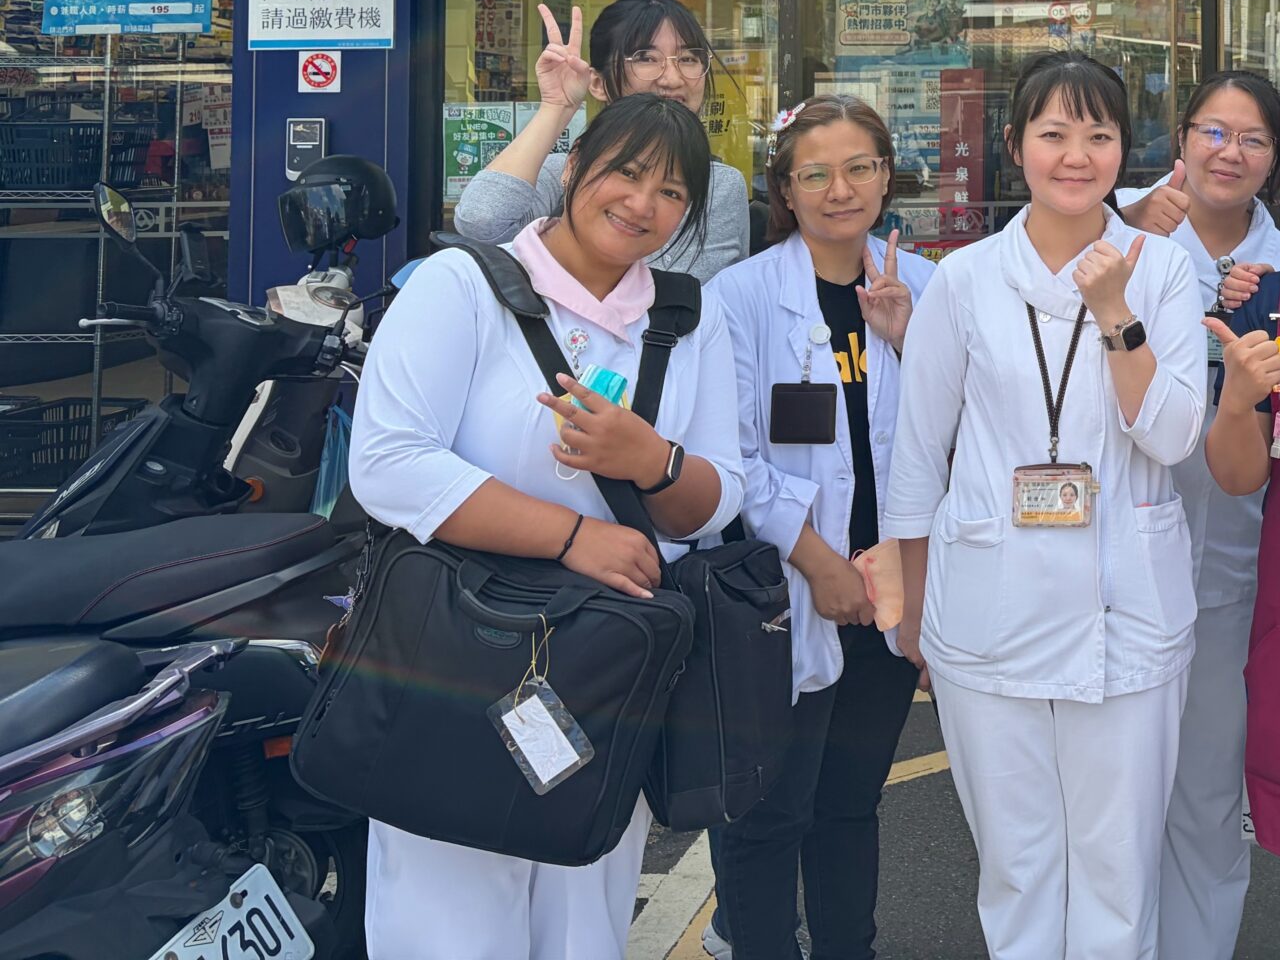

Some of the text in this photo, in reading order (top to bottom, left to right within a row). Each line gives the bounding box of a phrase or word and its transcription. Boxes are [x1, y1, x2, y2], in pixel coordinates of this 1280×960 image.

[150, 5, 170, 14] 195
[858, 4, 906, 16] 門市夥伴
[260, 6, 382, 31] 請過繳費機
